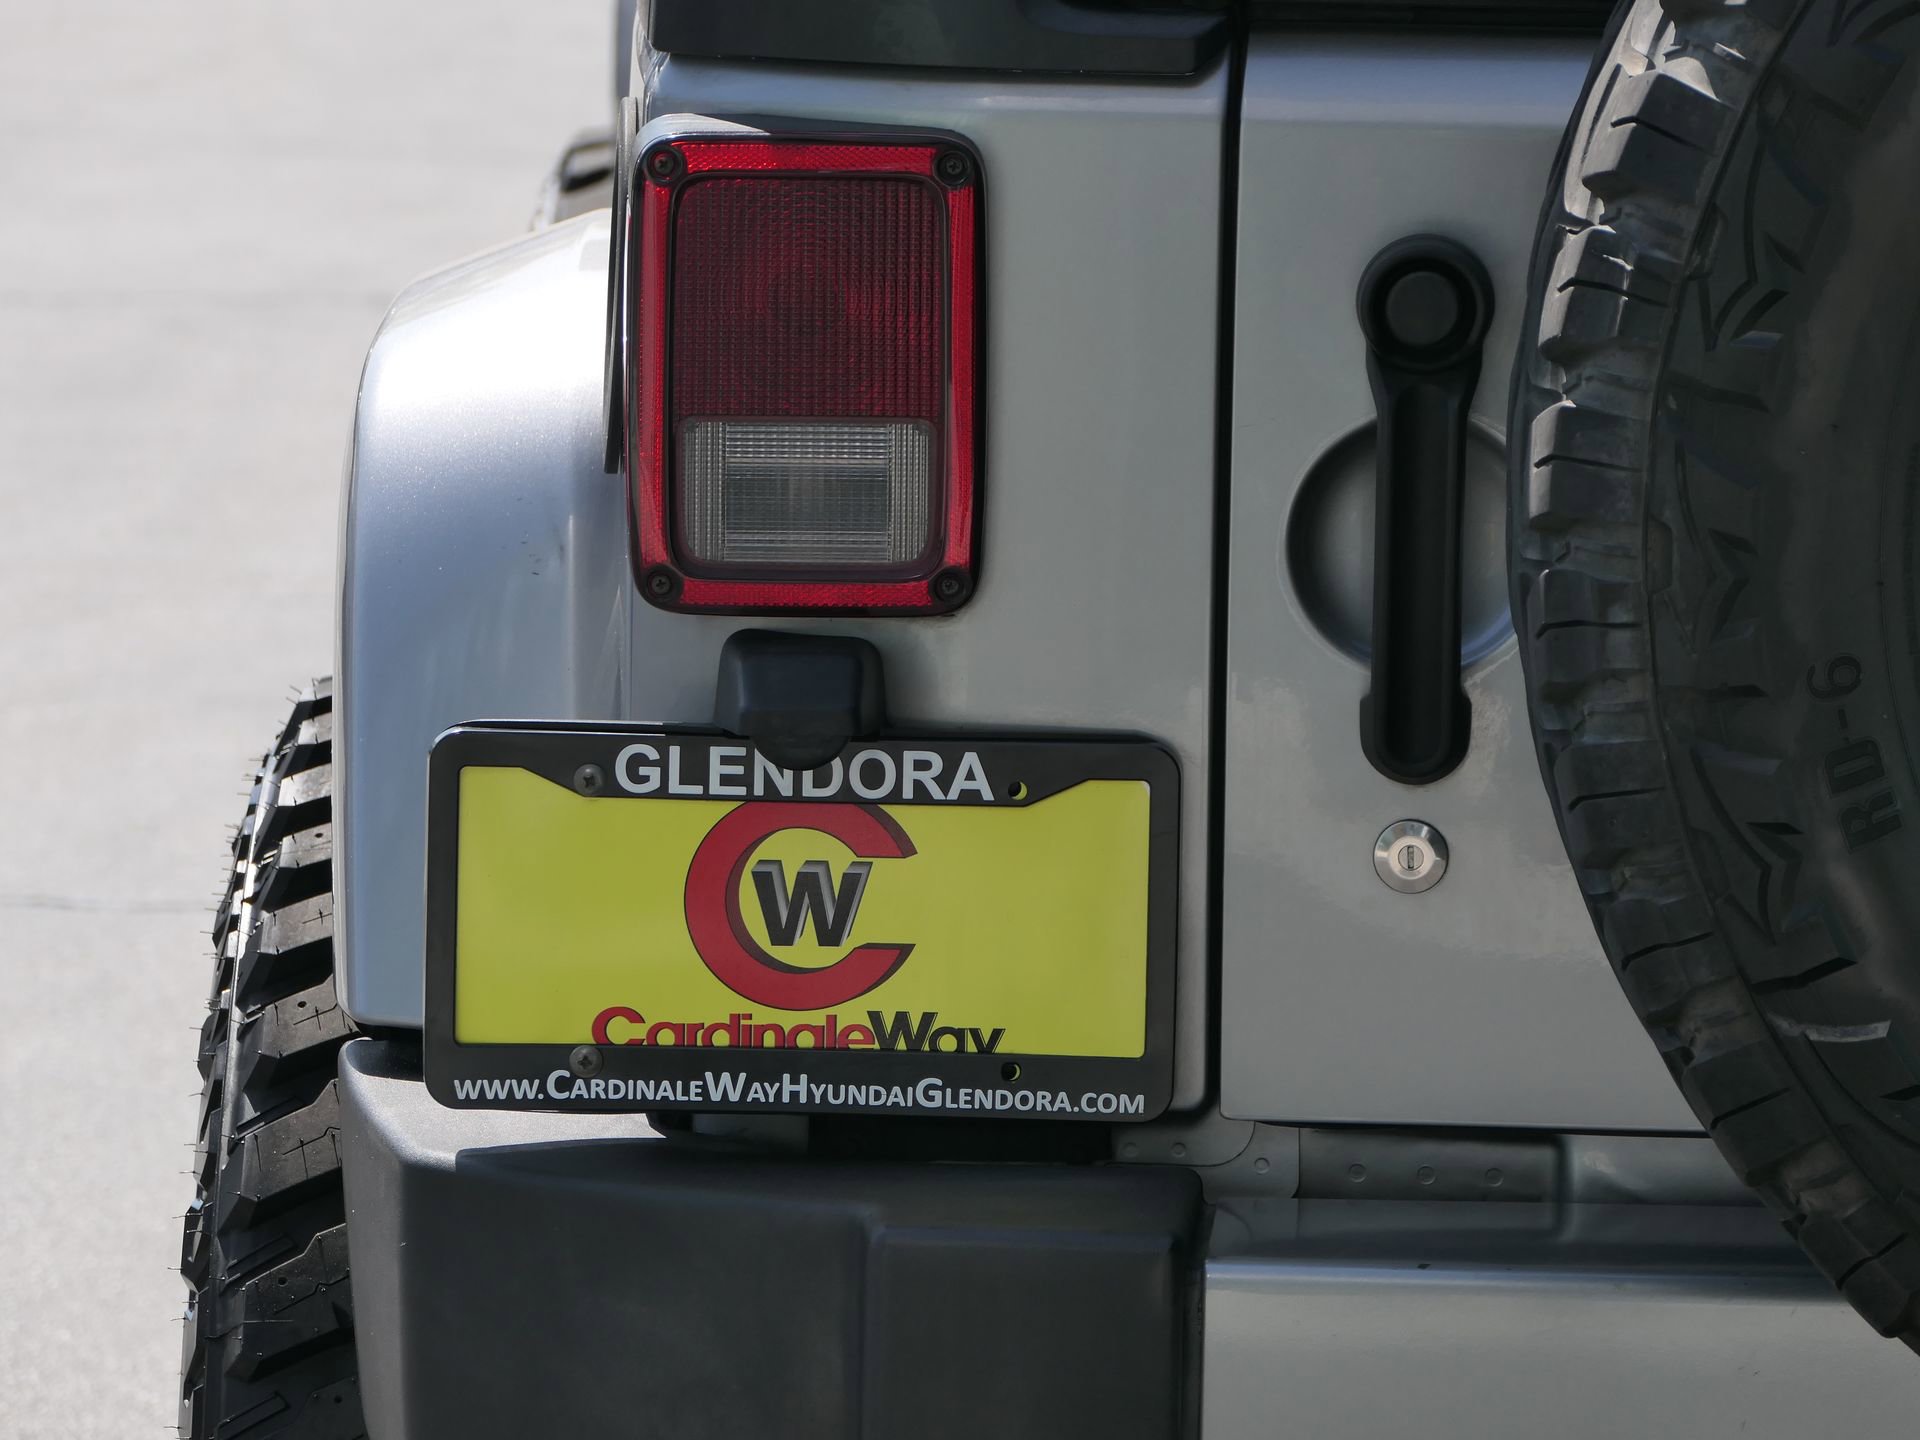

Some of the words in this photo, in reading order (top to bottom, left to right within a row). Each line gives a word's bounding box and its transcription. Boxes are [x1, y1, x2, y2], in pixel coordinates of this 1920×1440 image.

[615, 743, 995, 801] GLENDORA
[1806, 655, 1903, 853] RD-6
[592, 1006, 1006, 1054] CardinaleWay
